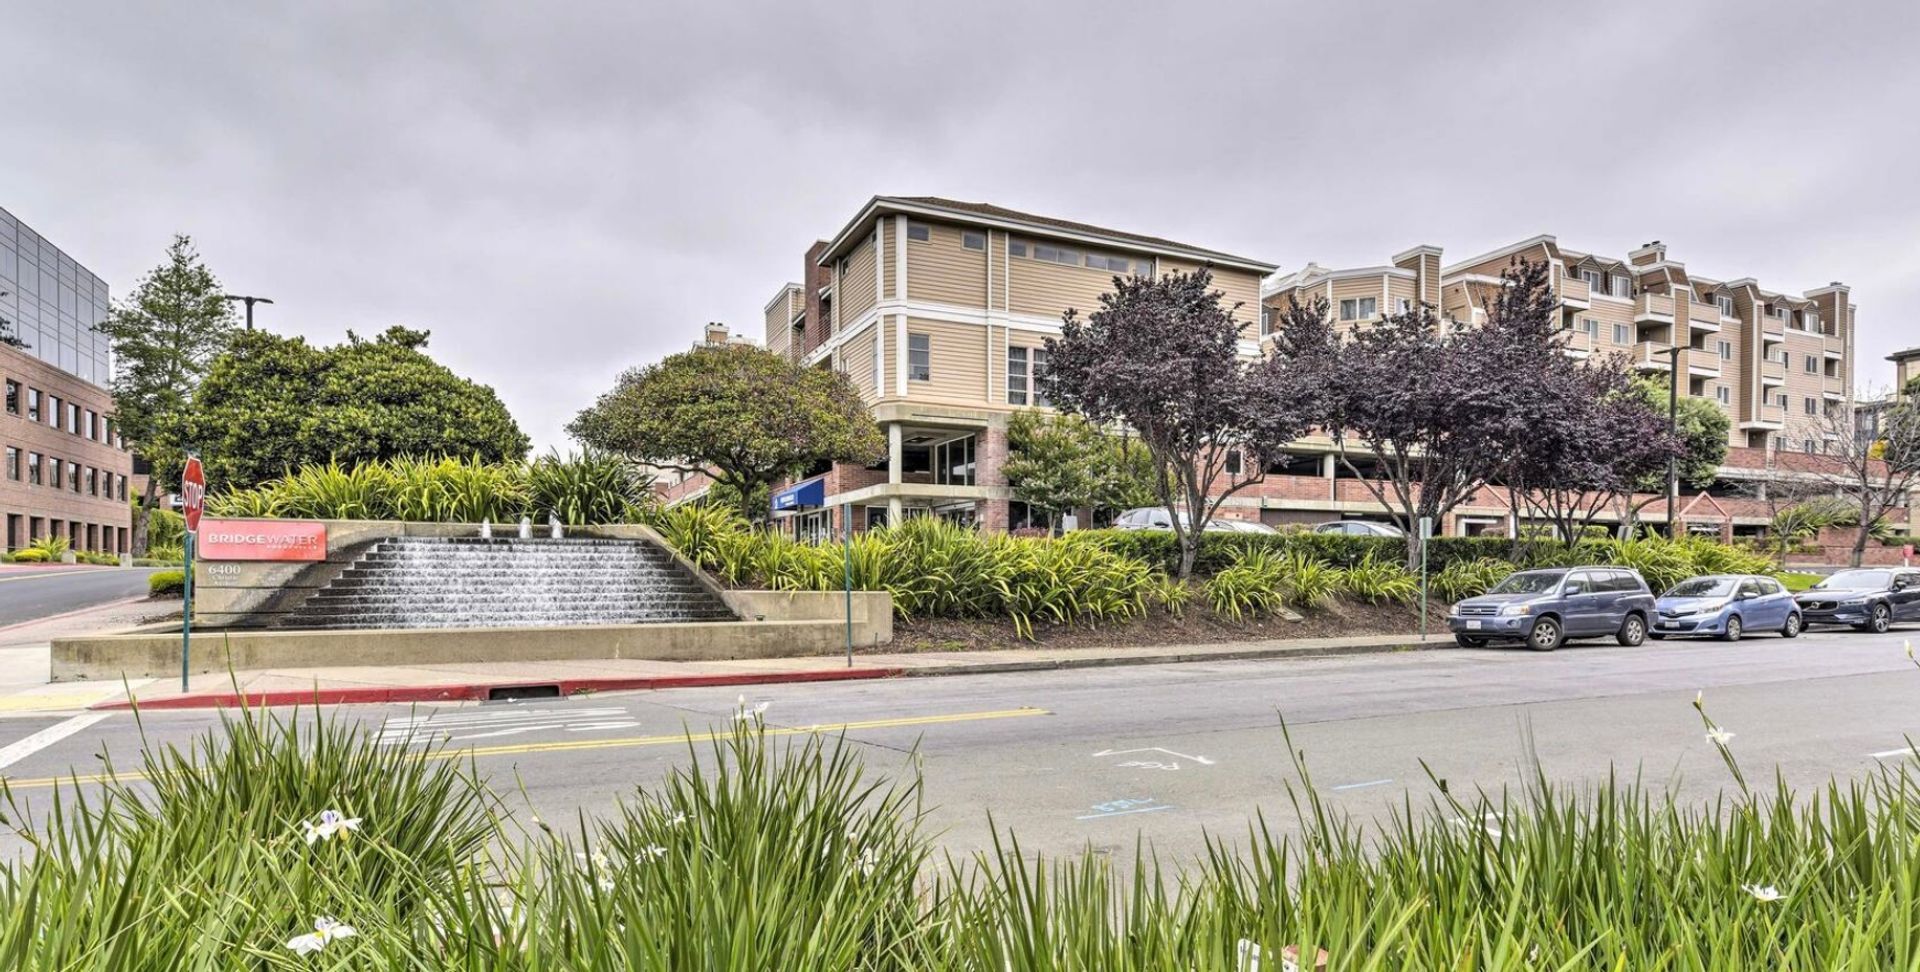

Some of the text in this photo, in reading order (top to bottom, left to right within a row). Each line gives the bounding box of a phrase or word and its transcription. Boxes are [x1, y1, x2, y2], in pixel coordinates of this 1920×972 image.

[184, 480, 203, 509] STOP
[208, 533, 318, 545] BRIDGEWATER
[208, 564, 241, 575] 6400
